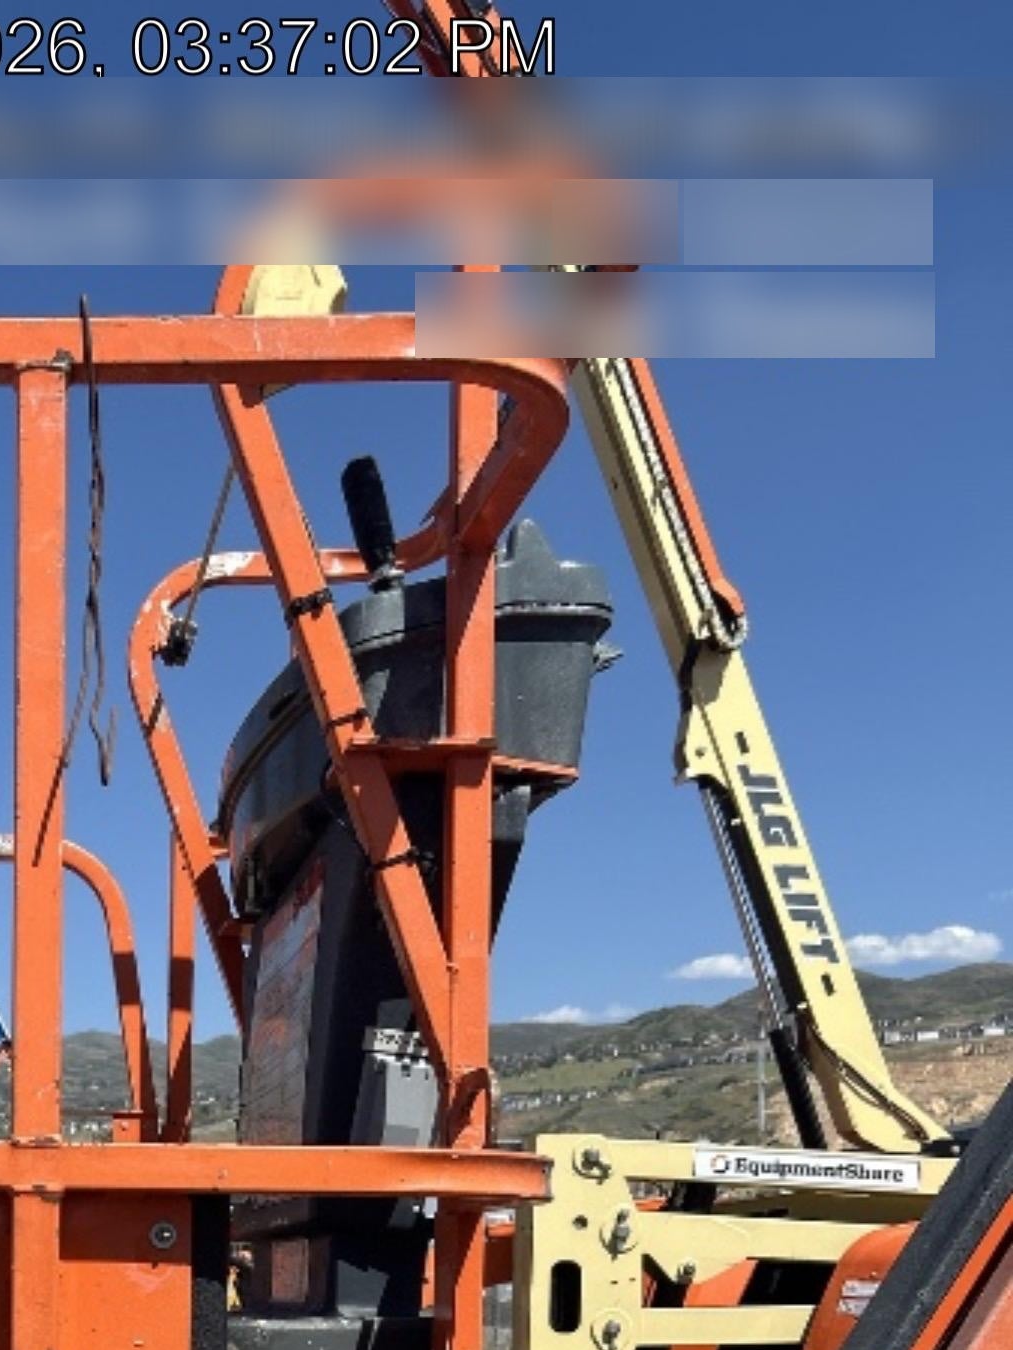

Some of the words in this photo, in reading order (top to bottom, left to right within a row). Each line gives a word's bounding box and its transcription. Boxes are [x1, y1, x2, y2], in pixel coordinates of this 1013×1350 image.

[736, 763, 799, 847] JLG
[773, 864, 840, 964] LIFT
[734, 1157, 904, 1182] EquipmentShare
